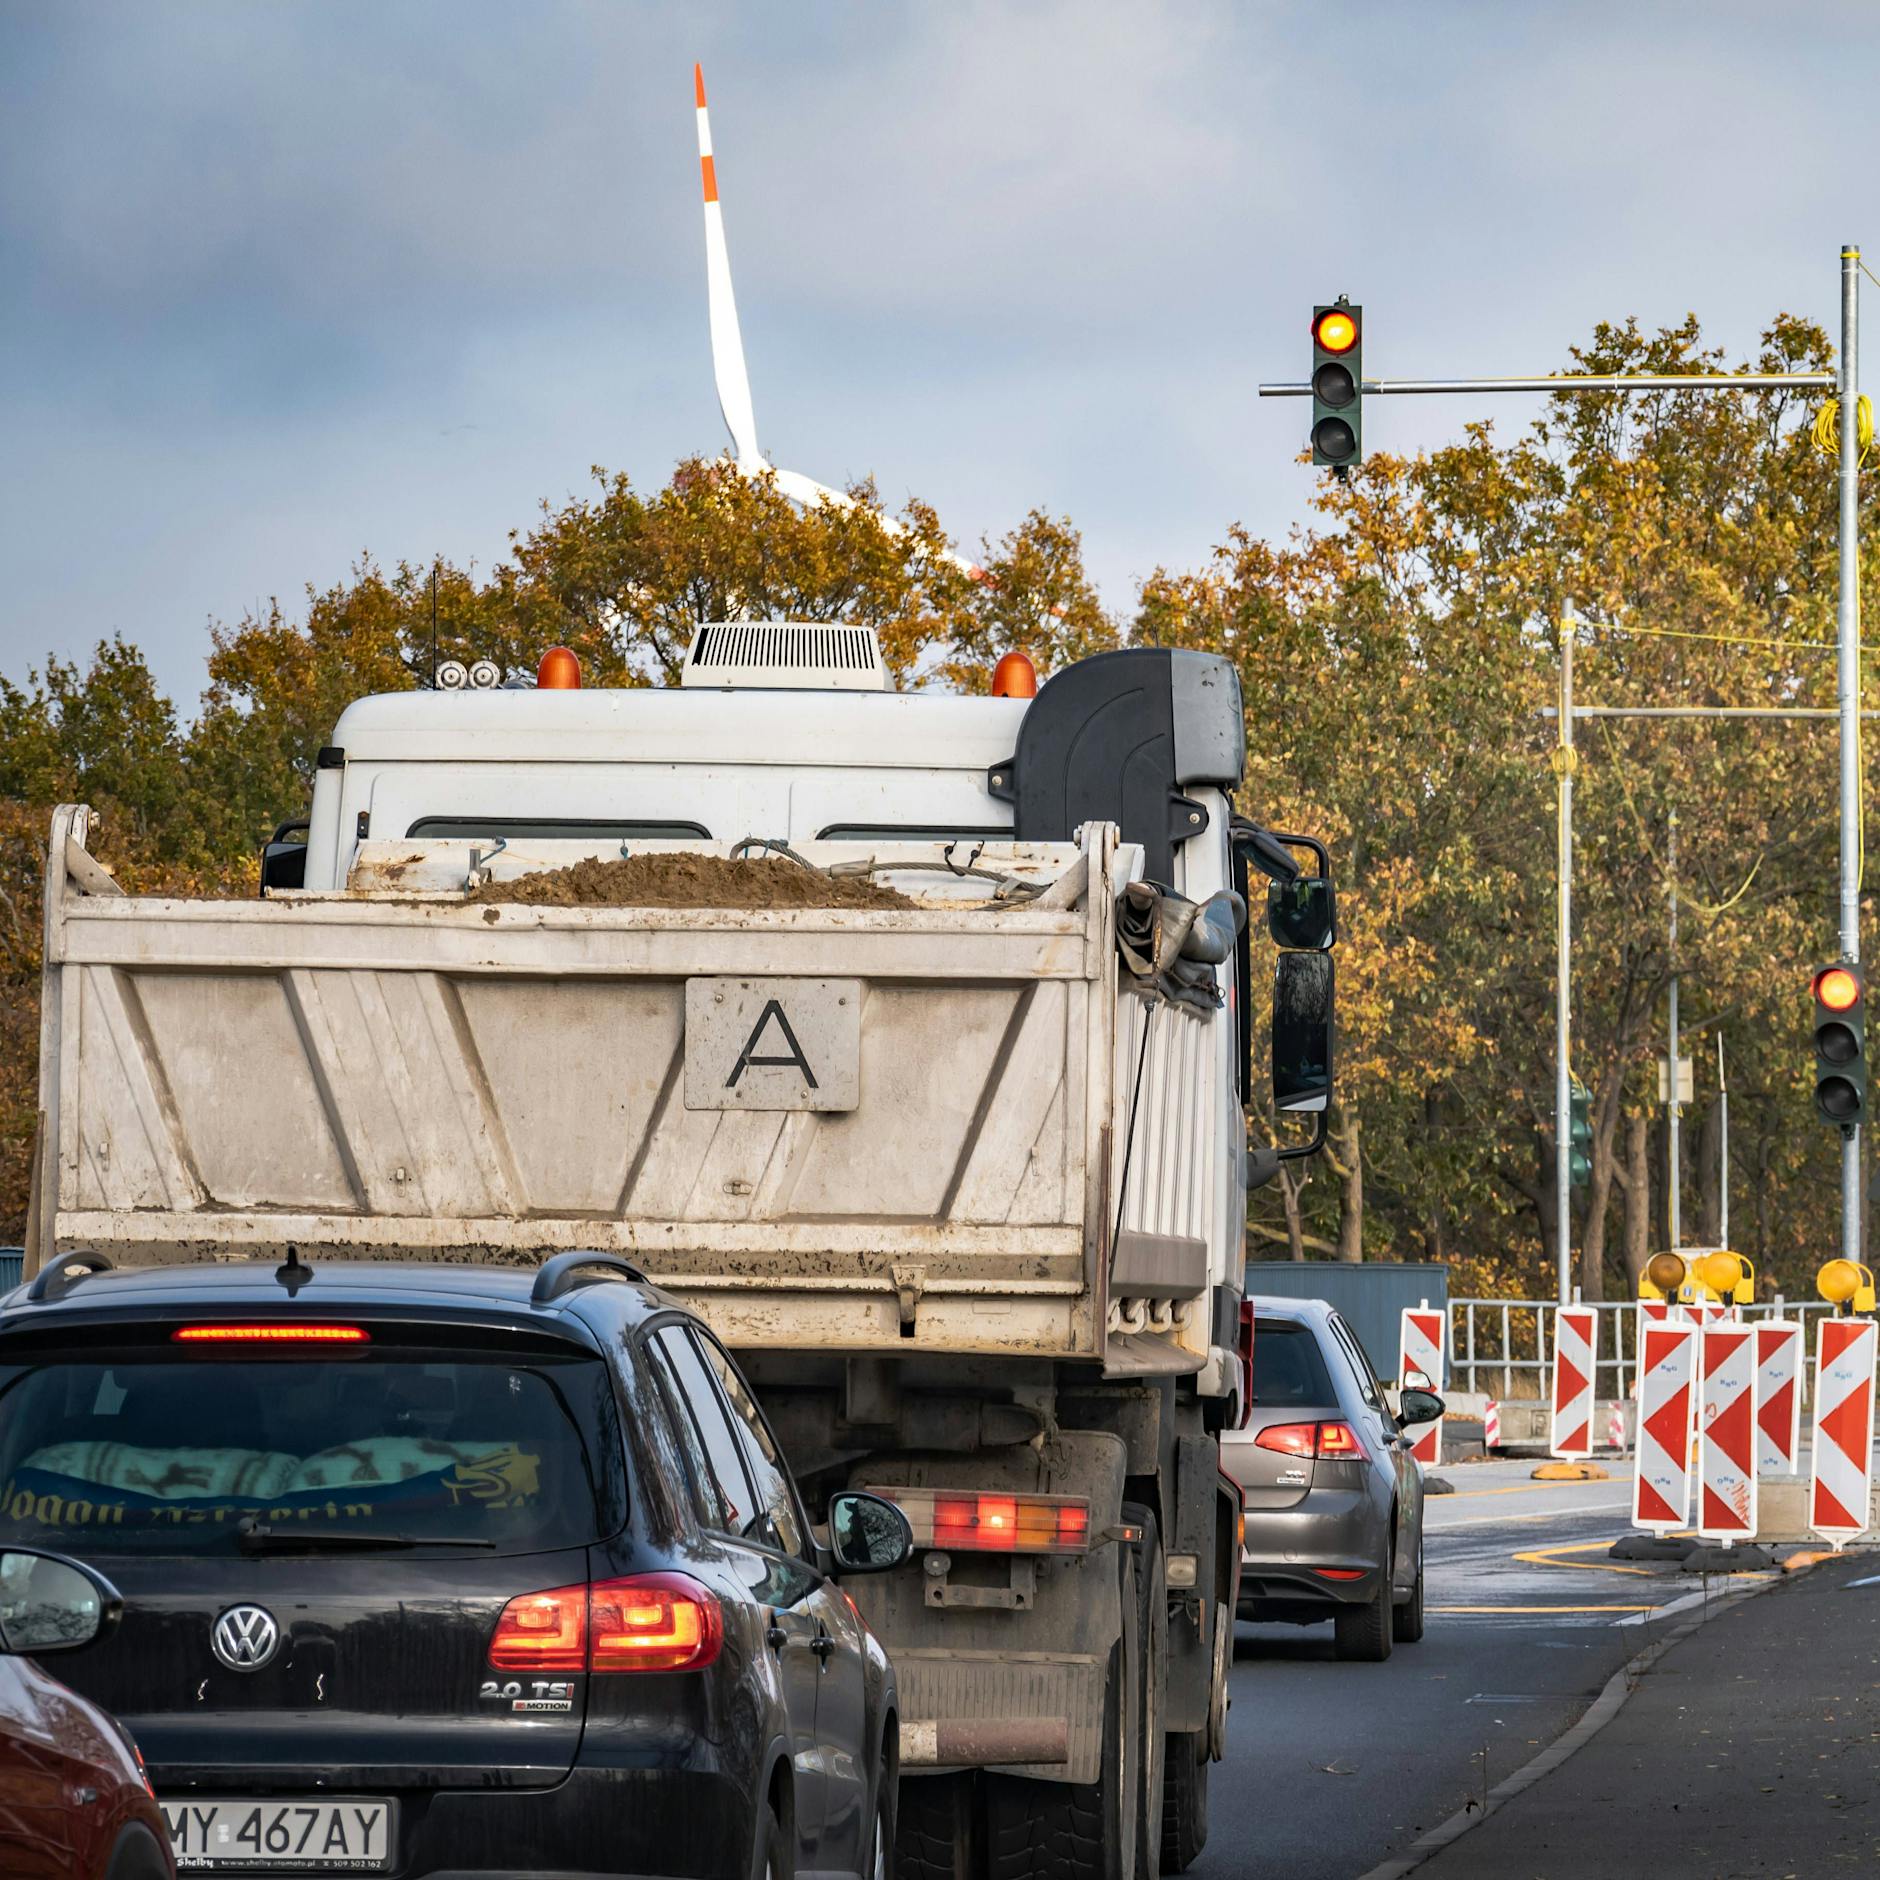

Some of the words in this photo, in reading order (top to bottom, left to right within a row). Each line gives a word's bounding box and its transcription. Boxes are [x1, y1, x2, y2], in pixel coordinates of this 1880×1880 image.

[725, 999, 820, 1089] A
[217, 1606, 275, 1666] VW
[480, 1681, 522, 1699] 2.0
[531, 1682, 575, 1699] TSI
[236, 1807, 381, 1855] 467AY
[176, 1858, 214, 1869] Shelby
[333, 1860, 348, 1868] 509
[350, 1860, 366, 1868] 502
[368, 1860, 381, 1869] 162
